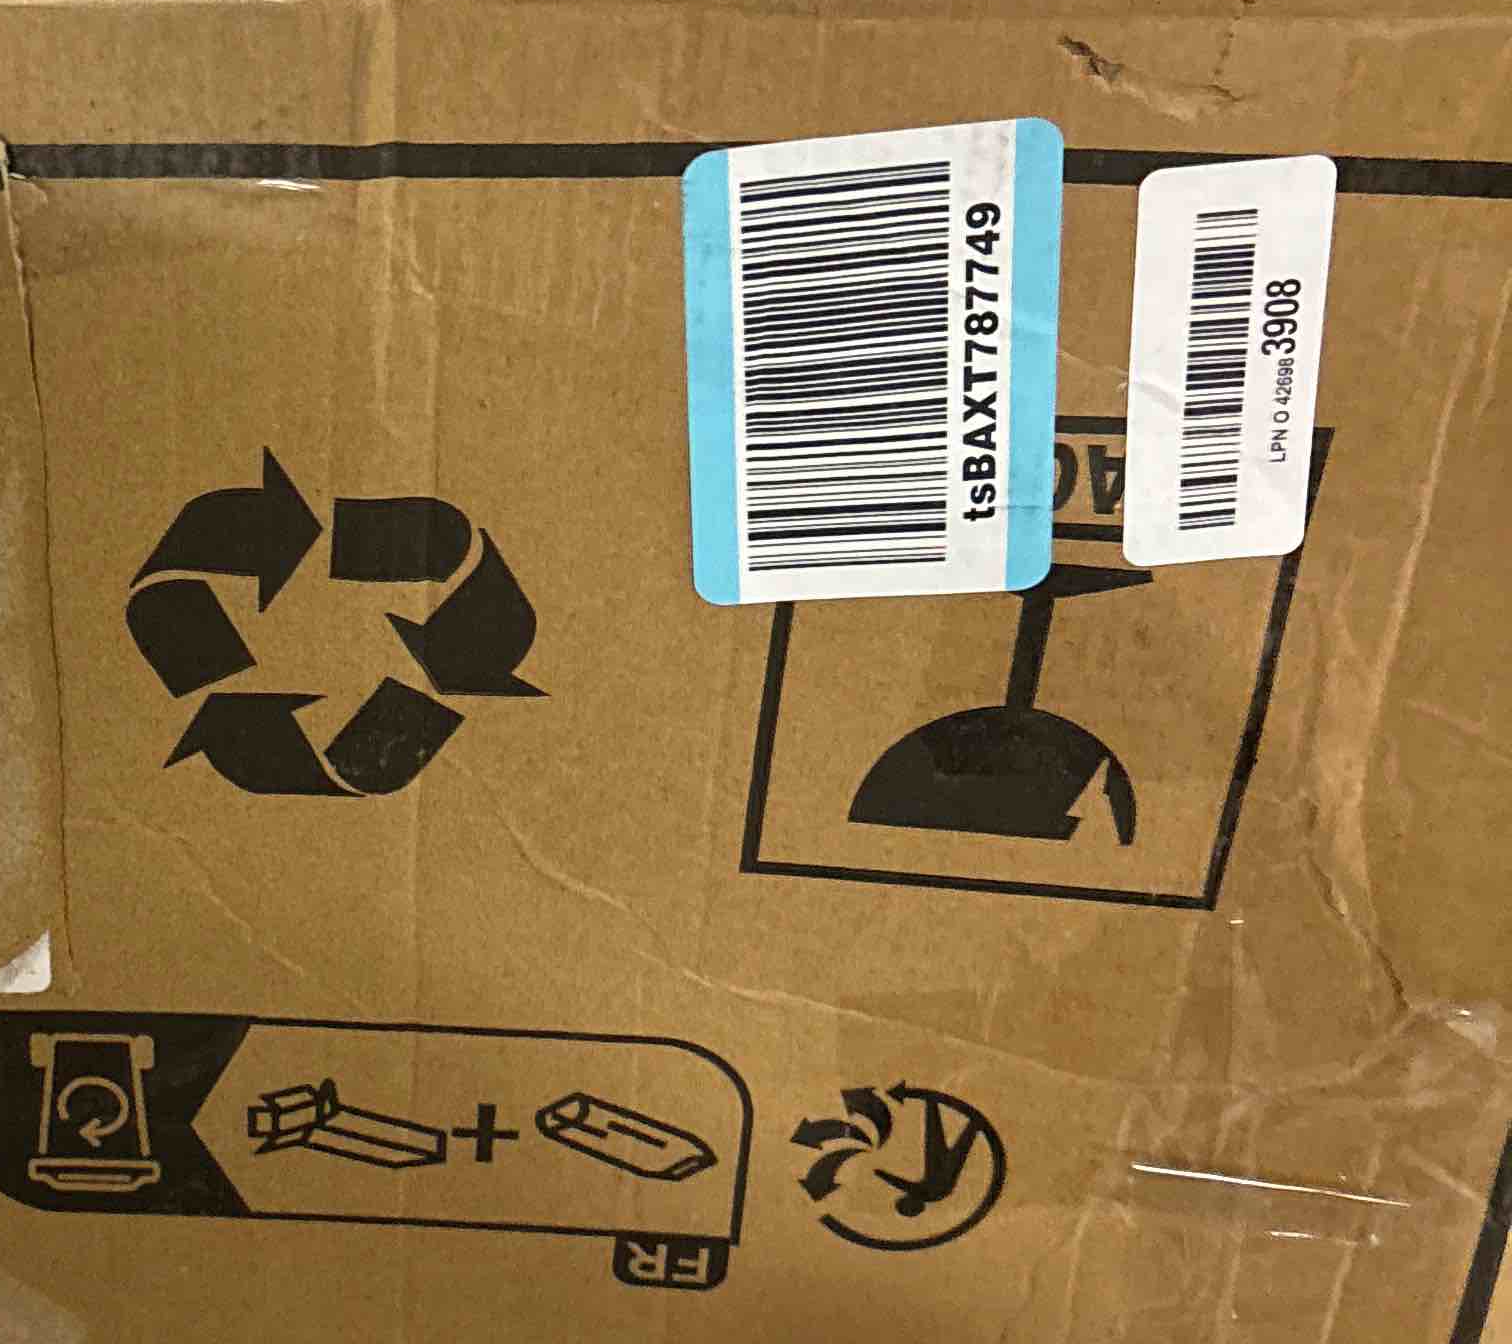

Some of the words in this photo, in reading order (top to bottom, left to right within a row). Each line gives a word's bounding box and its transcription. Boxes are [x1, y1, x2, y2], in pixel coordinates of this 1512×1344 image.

[962, 202, 1002, 523] tsBAXT787749
[1269, 429, 1290, 464] LPN
[626, 1240, 710, 1284] FR
